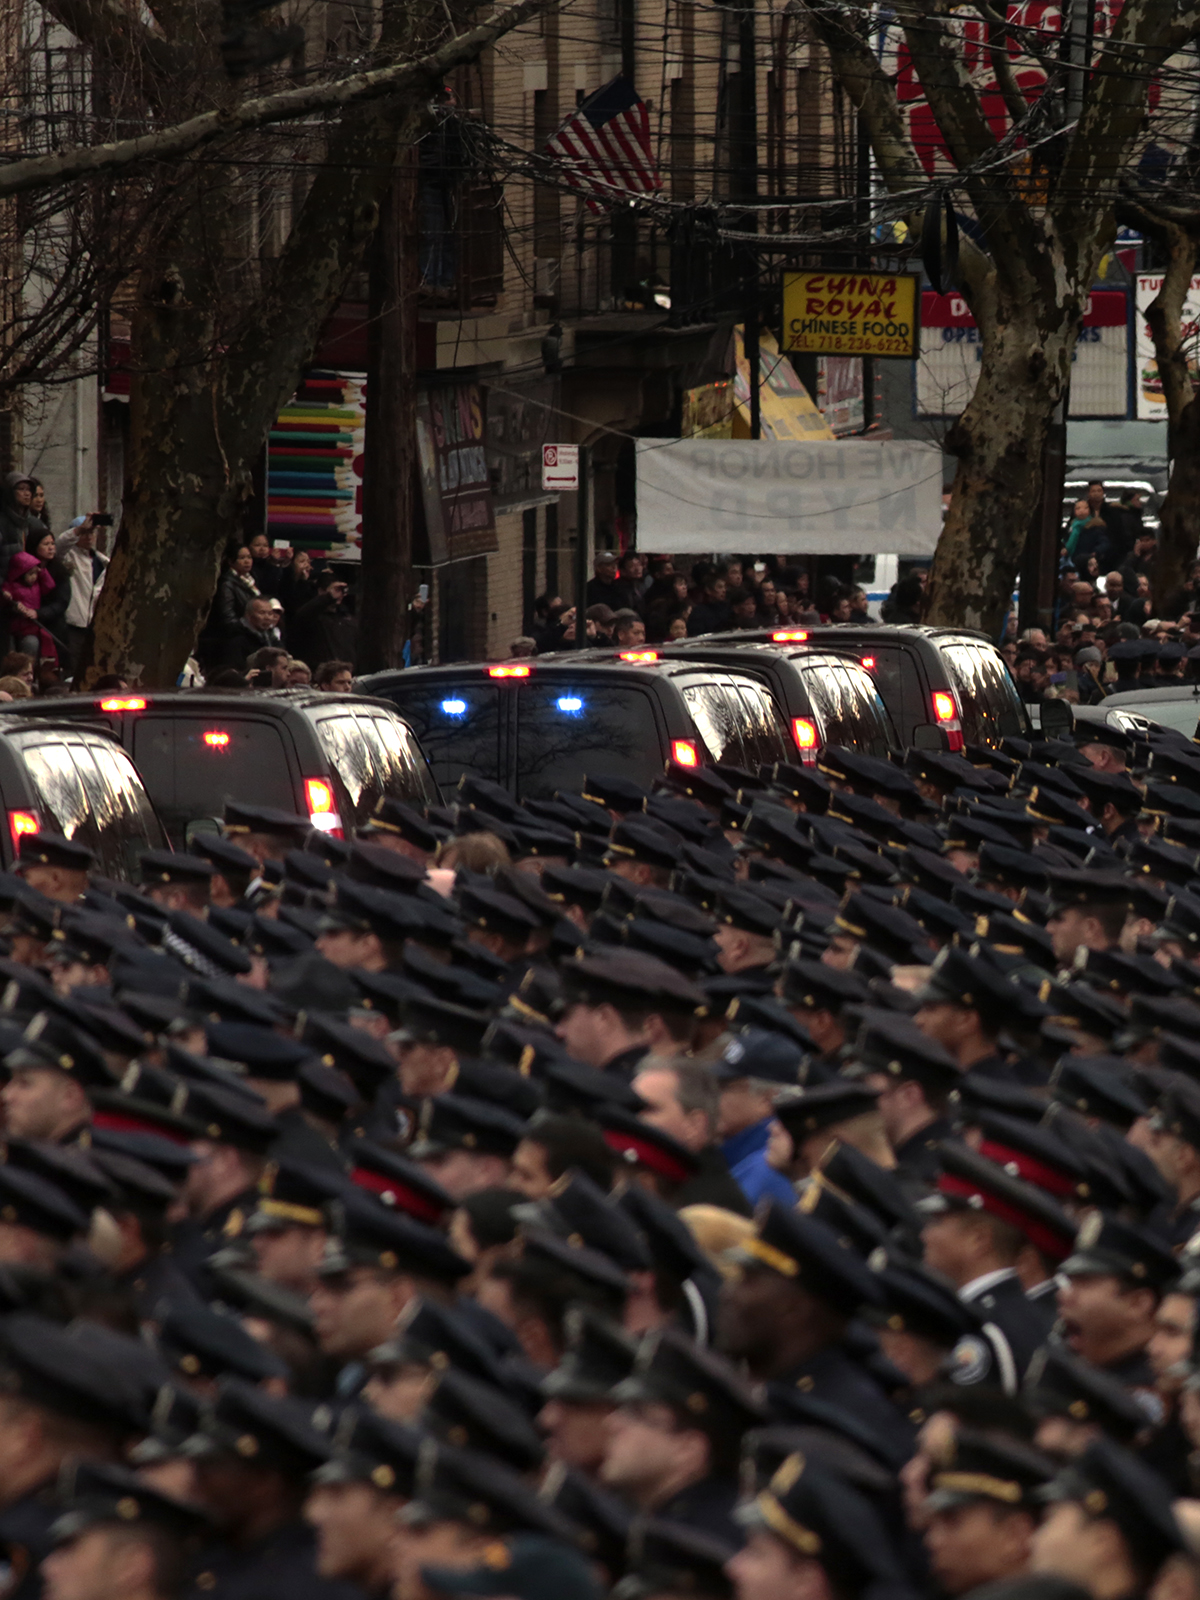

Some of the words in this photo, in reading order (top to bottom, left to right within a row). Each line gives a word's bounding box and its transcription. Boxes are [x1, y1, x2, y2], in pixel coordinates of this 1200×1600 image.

[805, 275, 897, 297] CHINA
[805, 298, 898, 320] ROYAL
[790, 319, 857, 336] CHINESE
[862, 321, 910, 337] FOOD
[942, 328, 982, 343] OPE
[819, 336, 911, 352] 718-236-6222
